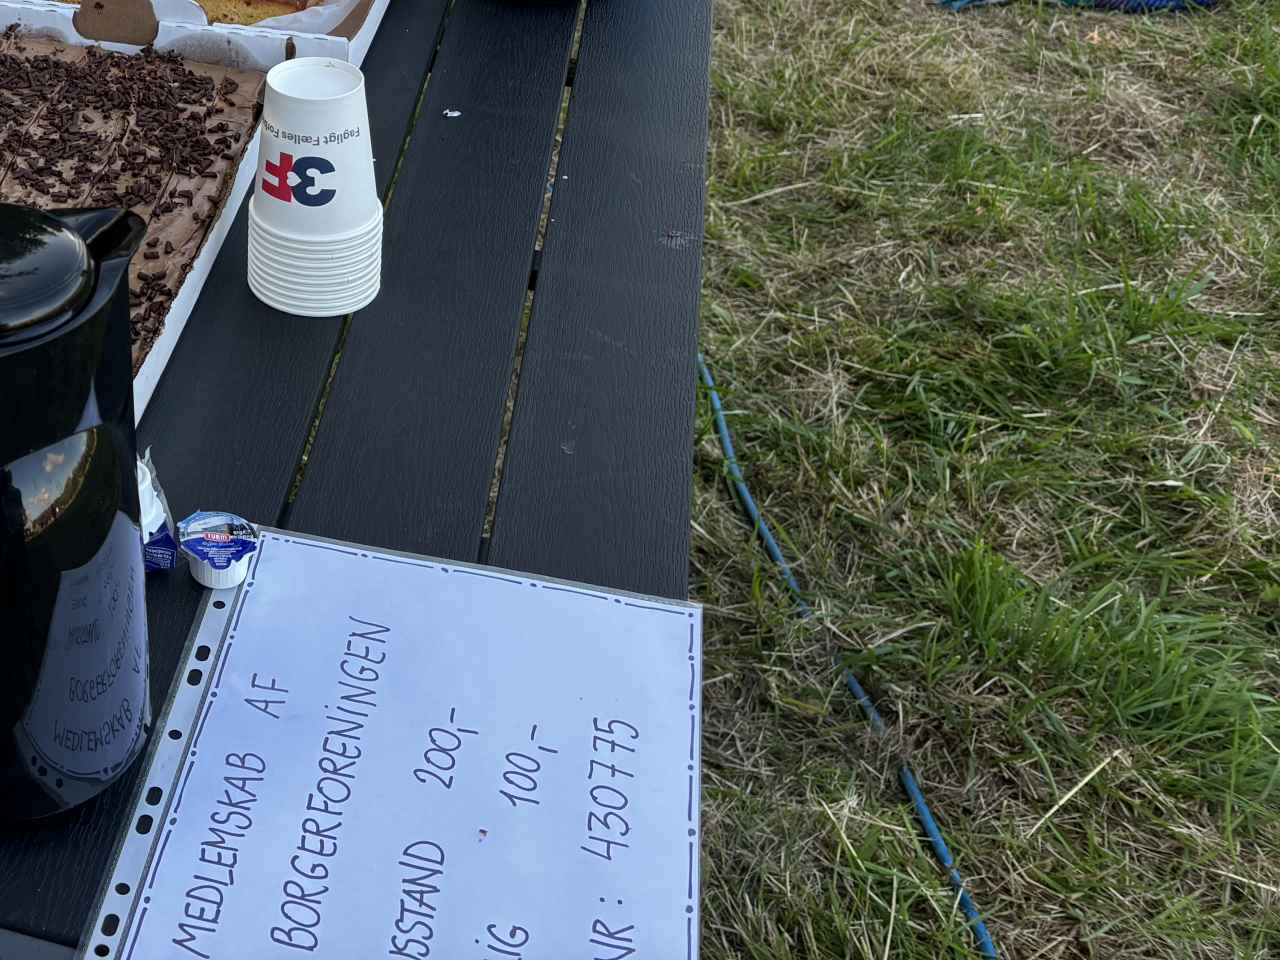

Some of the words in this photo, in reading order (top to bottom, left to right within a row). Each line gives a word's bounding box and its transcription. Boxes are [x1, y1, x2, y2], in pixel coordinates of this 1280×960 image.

[263, 119, 279, 138] Forb
[281, 131, 320, 146] Fælles
[323, 127, 360, 145] Fagligt
[261, 151, 337, 208] 3F
[270, 615, 392, 953] BORGERFORENINGEN
[498, 724, 559, 807] 100,-
[580, 716, 640, 861] 430775
[172, 751, 267, 960] MEDLEMSKAB
[244, 672, 290, 720] AF
